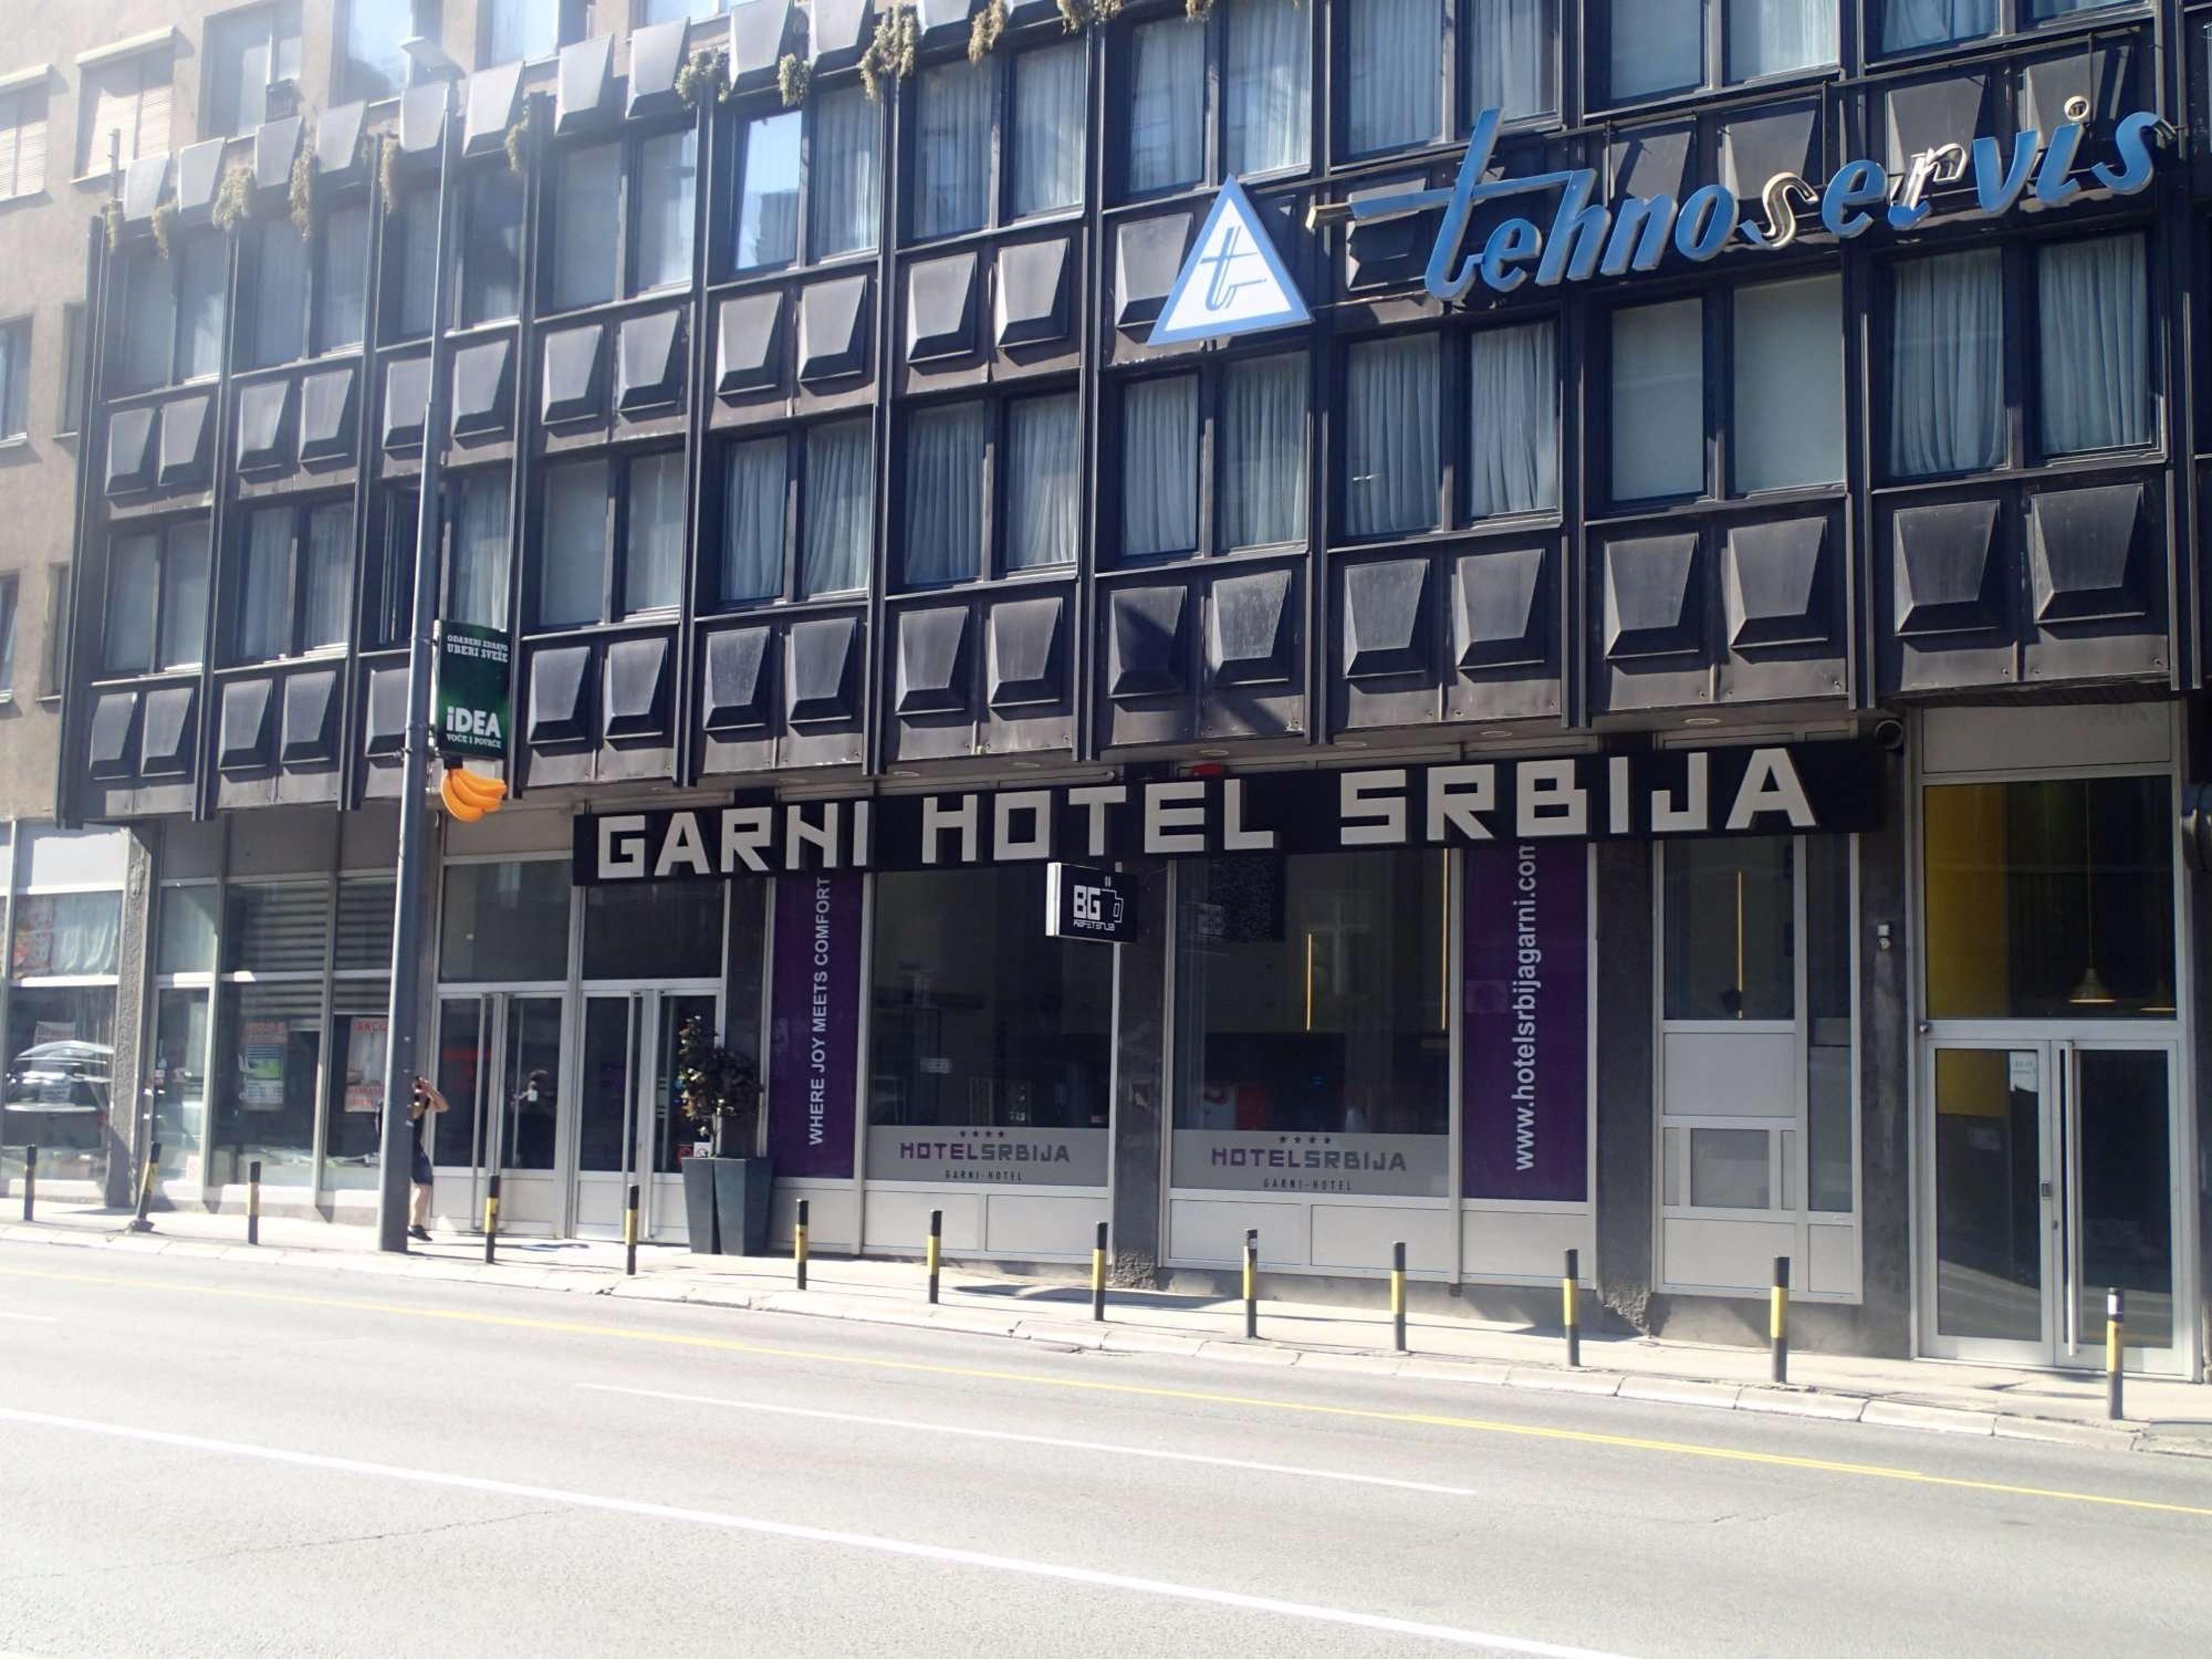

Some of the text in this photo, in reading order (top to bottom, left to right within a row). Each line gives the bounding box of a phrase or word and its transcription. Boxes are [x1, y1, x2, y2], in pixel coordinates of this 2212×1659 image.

[1305, 94, 2176, 301] tehnoservis
[447, 643, 479, 657] UBERI
[598, 748, 1818, 880] GARNI HOTEL SRBIJA
[1074, 885, 1101, 921] BG
[809, 877, 831, 1145] WHERE JOY MEETS COMFORT
